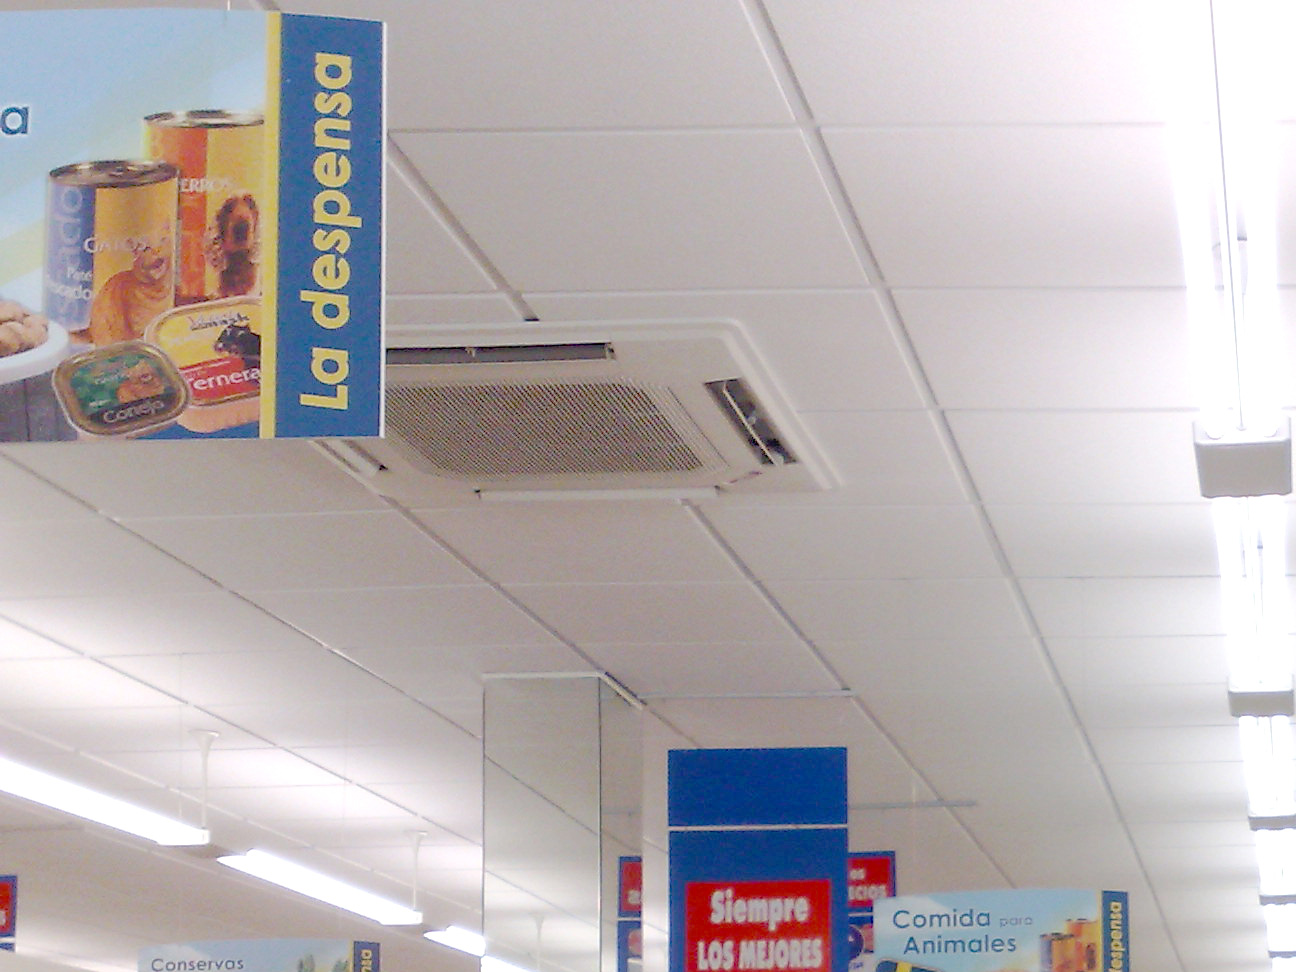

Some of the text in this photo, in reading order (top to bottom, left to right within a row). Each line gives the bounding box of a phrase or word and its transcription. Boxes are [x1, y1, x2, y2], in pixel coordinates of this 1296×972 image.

[300, 52, 362, 411] La despensa
[710, 888, 810, 931] Siempre
[892, 909, 1033, 929] Comida para
[697, 938, 823, 971] LOS MEJORES
[903, 934, 1017, 955] Animales
[150, 957, 245, 972] Conservas
